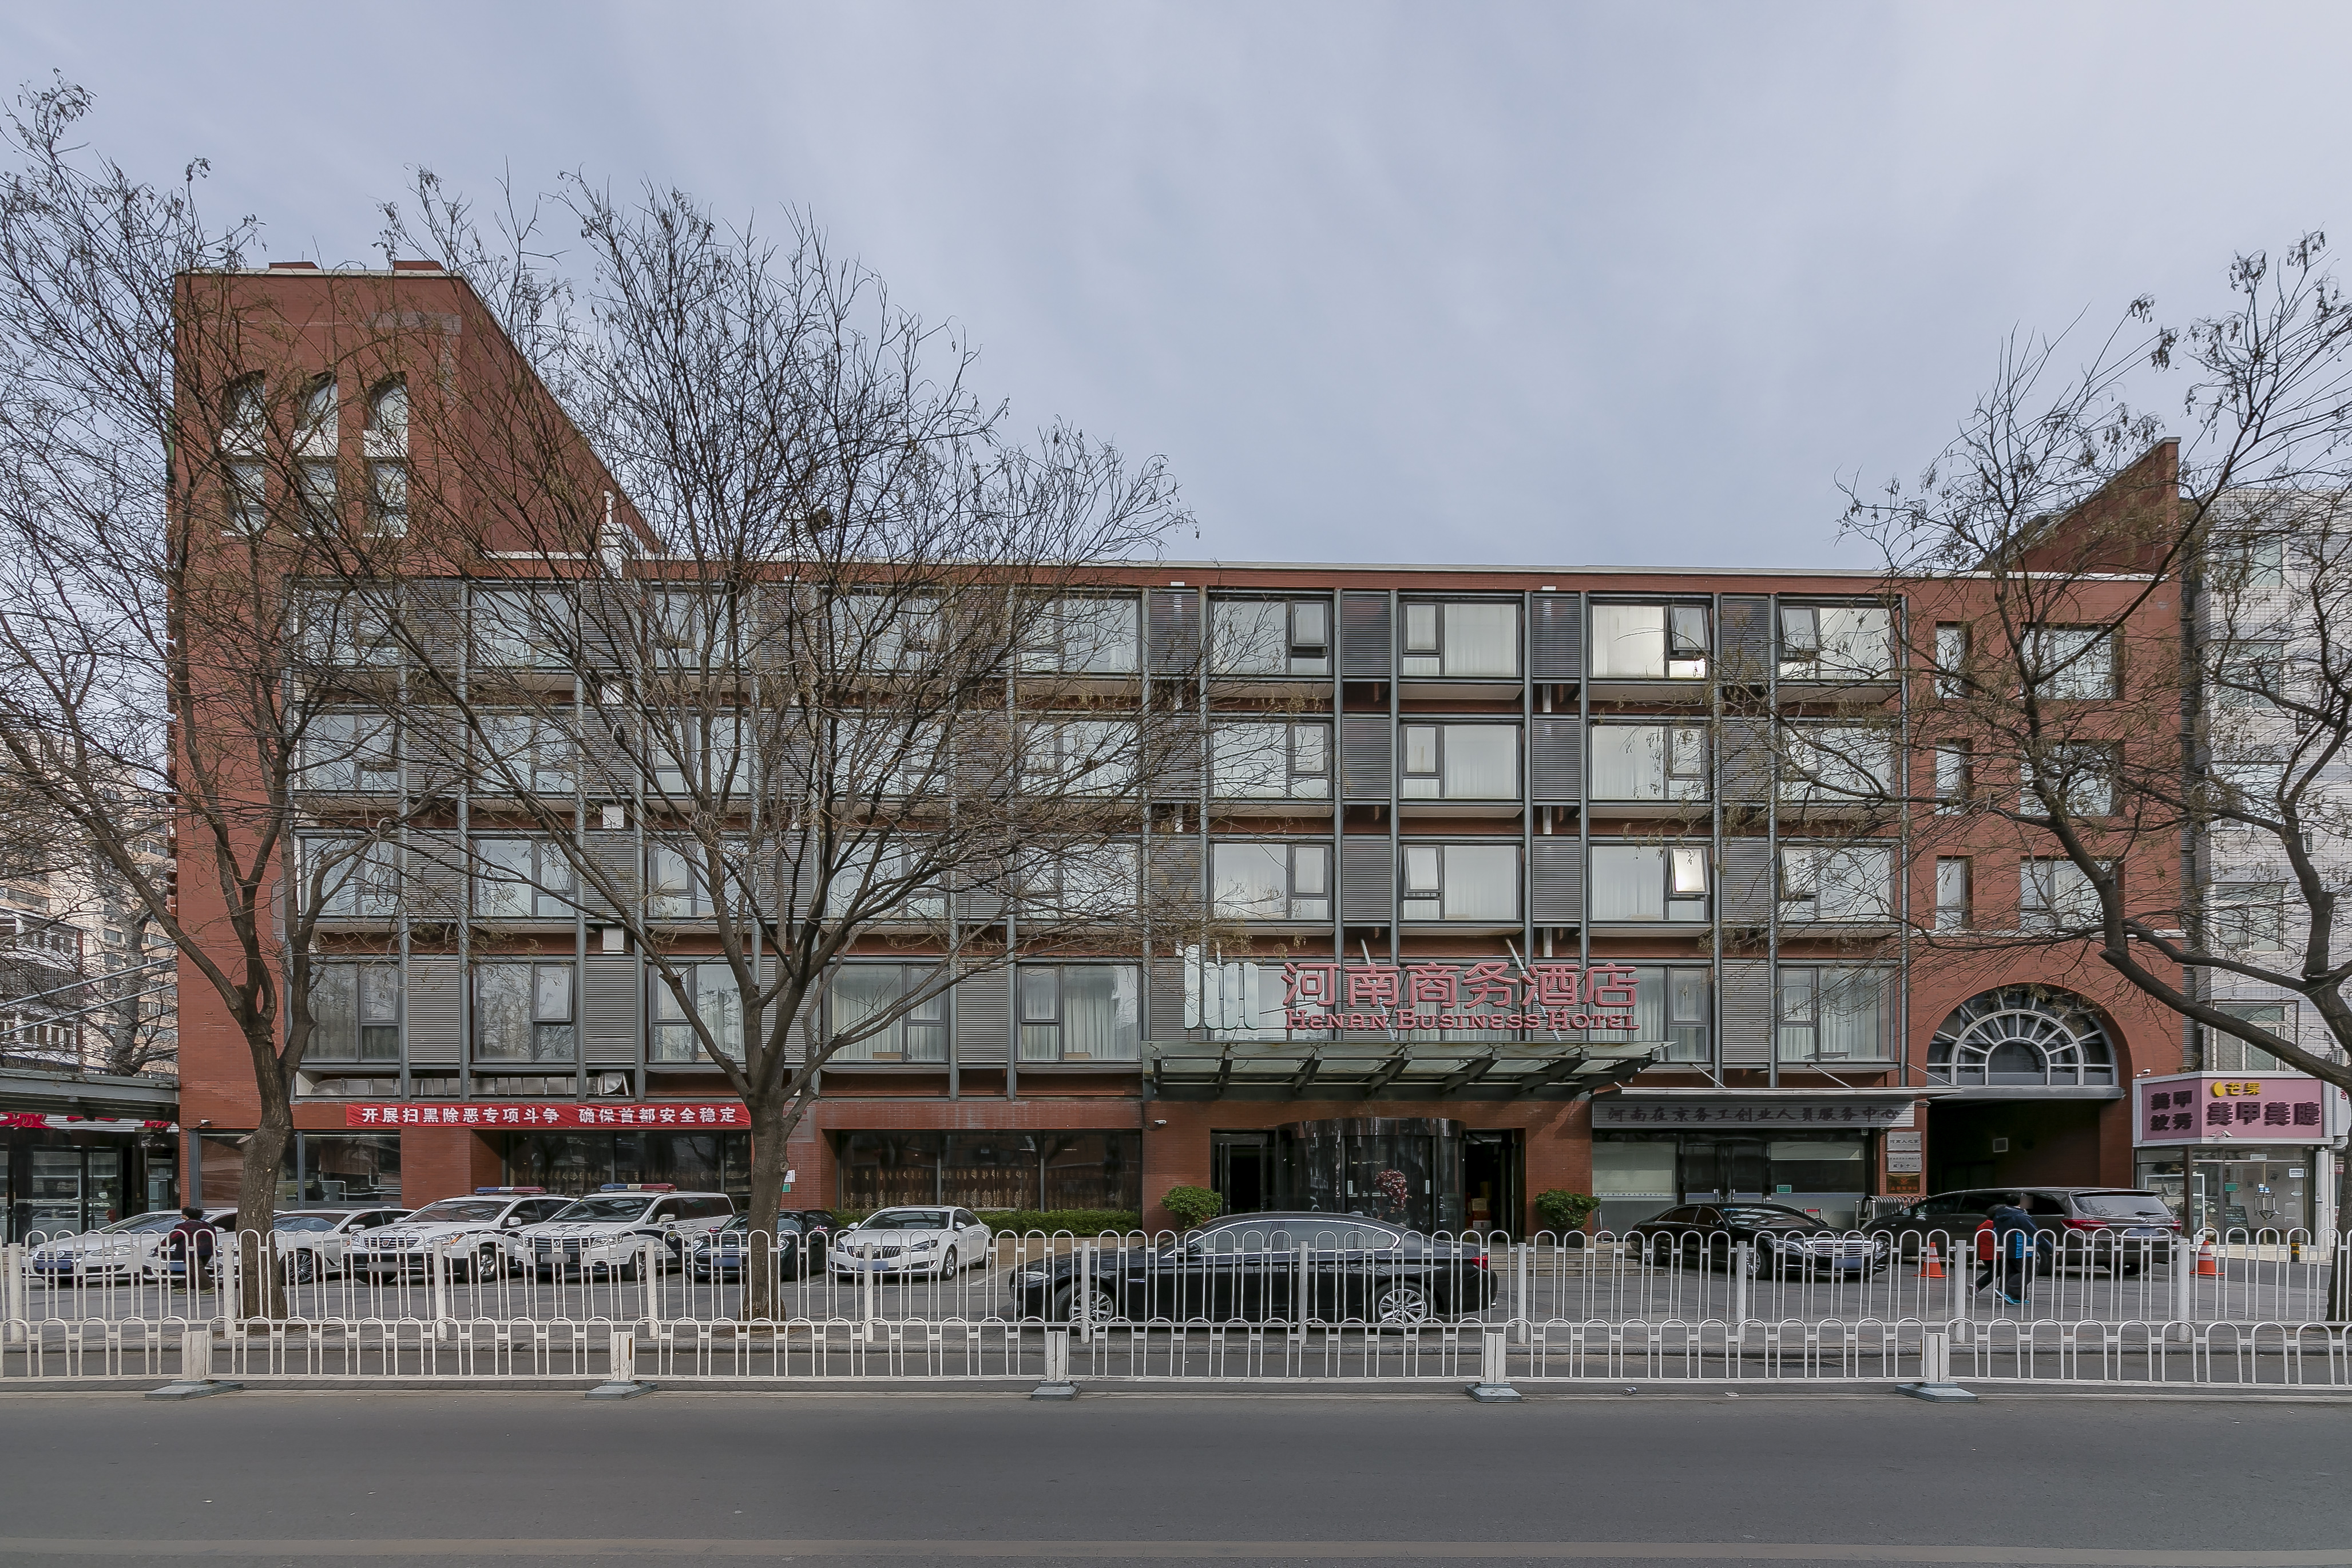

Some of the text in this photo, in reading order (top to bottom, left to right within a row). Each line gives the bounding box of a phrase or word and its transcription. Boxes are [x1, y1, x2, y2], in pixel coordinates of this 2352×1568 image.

[1280, 962, 1640, 1008] 河南商务酒店
[1285, 1009, 1640, 1031] HENAN BUSINESS HOTEL
[2150, 1089, 2194, 1110] 美甲
[2225, 1082, 2261, 1096] 芒果
[362, 1107, 736, 1124] 开展扫黑除恶专项斗争 确保首都安全稳定
[1607, 1106, 1901, 1123] 河南在京务工创业人员服务中心
[2206, 1101, 2321, 1126] 美甲美睫
